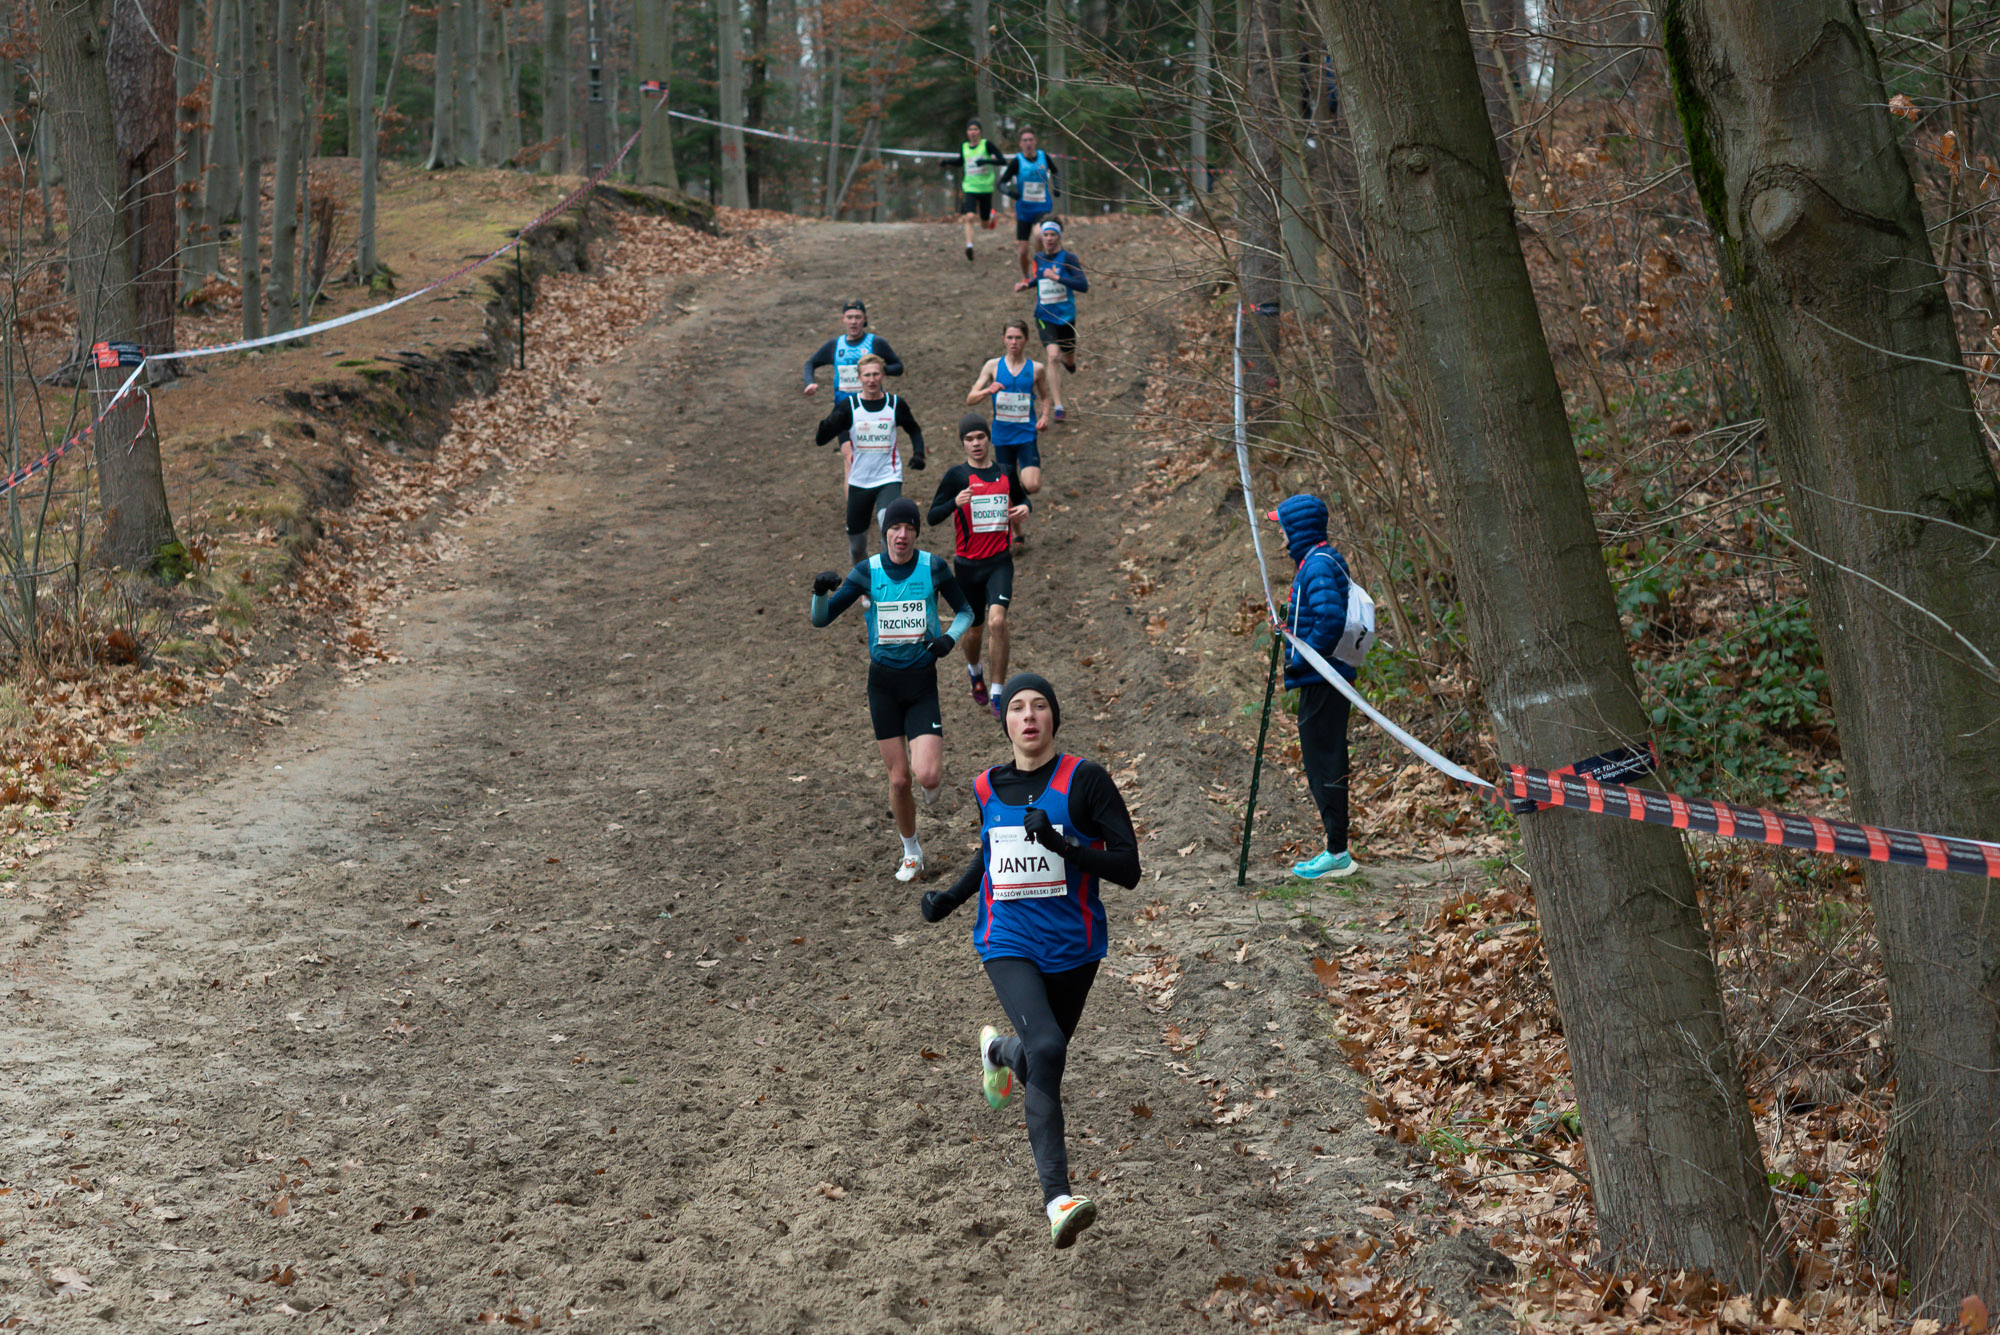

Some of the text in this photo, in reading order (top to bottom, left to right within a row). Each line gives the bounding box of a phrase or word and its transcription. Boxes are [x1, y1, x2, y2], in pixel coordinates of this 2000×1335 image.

[856, 434, 891, 442] MAJEWSKI
[993, 496, 1008, 504] 575
[902, 602, 923, 612] 598
[879, 617, 925, 629] TRZCIŃSKI
[998, 856, 1050, 873] JANTA
